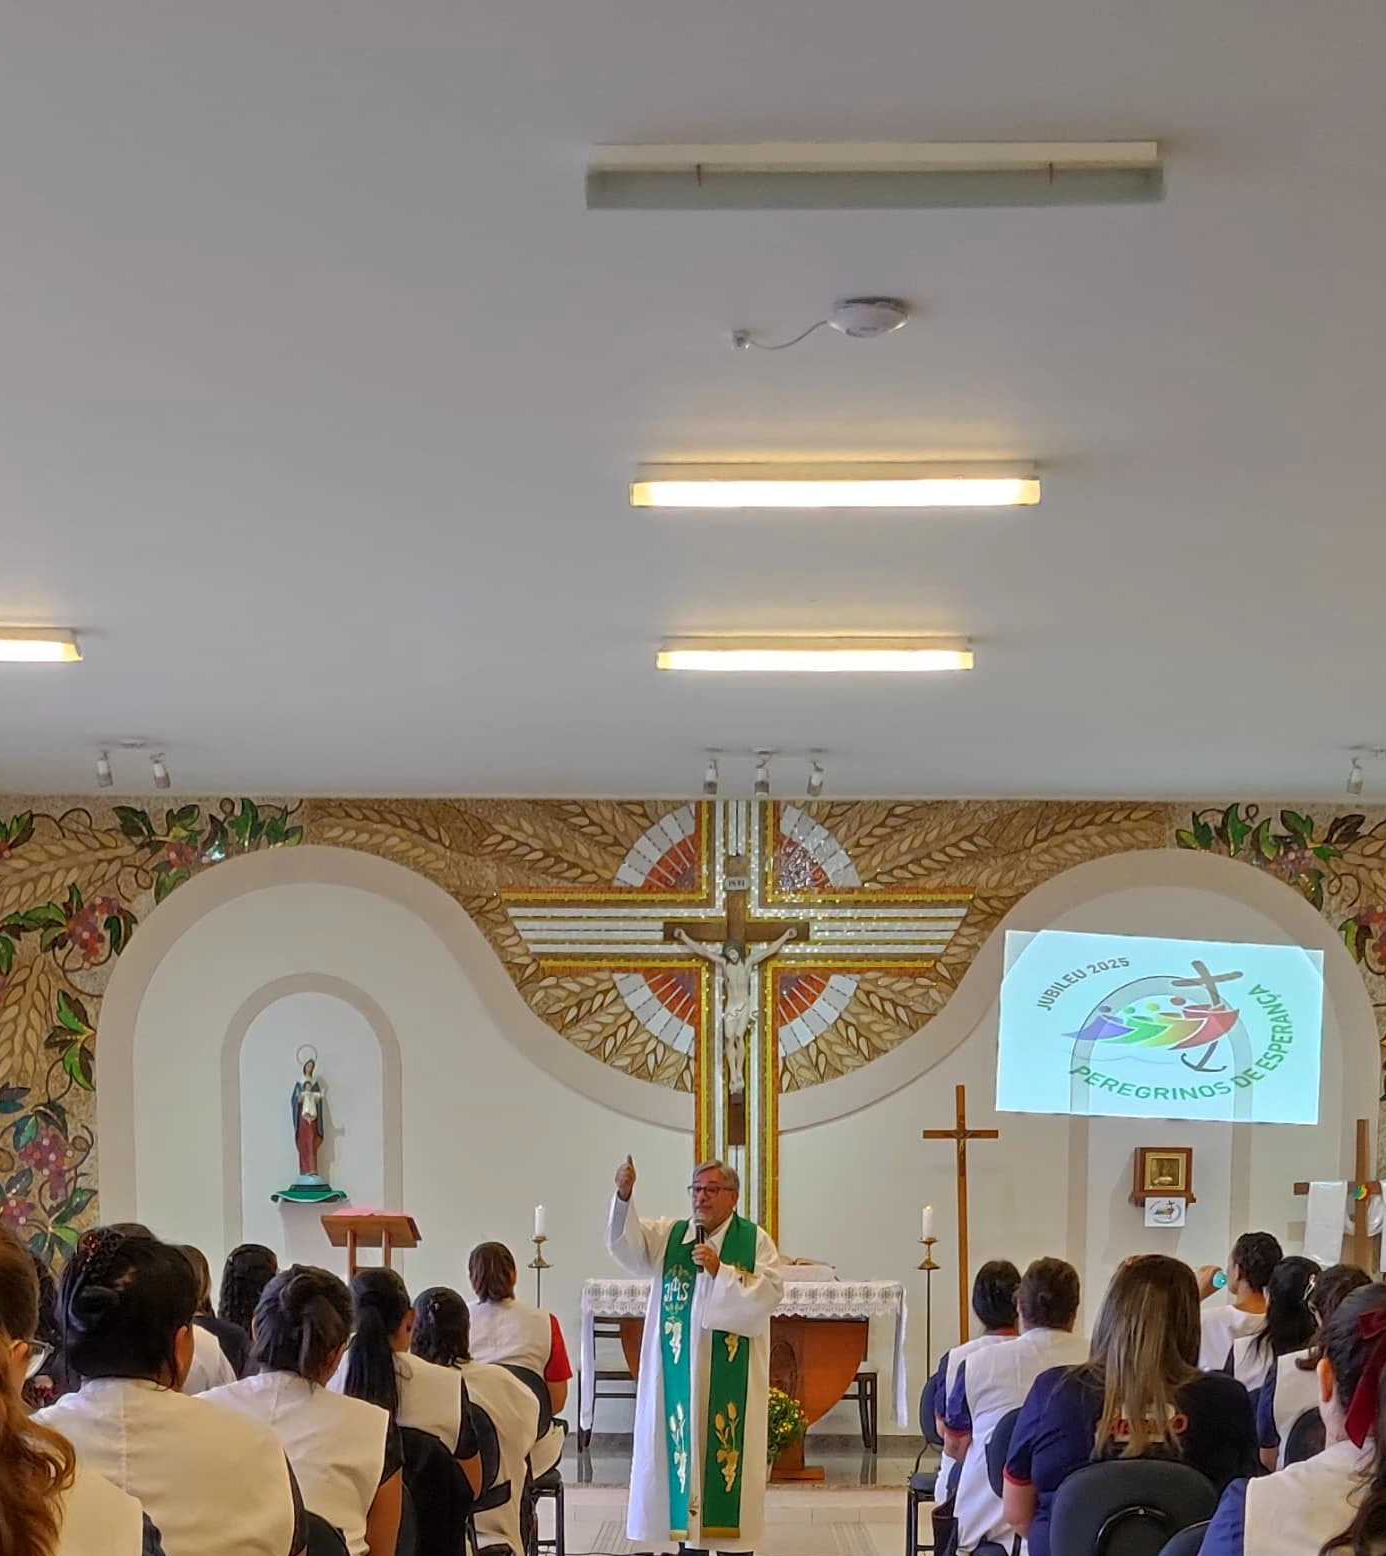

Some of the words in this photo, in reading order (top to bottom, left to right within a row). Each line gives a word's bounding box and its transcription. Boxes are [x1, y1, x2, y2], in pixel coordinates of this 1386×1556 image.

[1037, 969, 1087, 1012] JUBILEU
[1086, 957, 1130, 974] 2025
[1069, 1065, 1232, 1101] PEREGRINOS
[1230, 1067, 1265, 1089] DE
[1248, 984, 1294, 1071] ESPERANÇA
